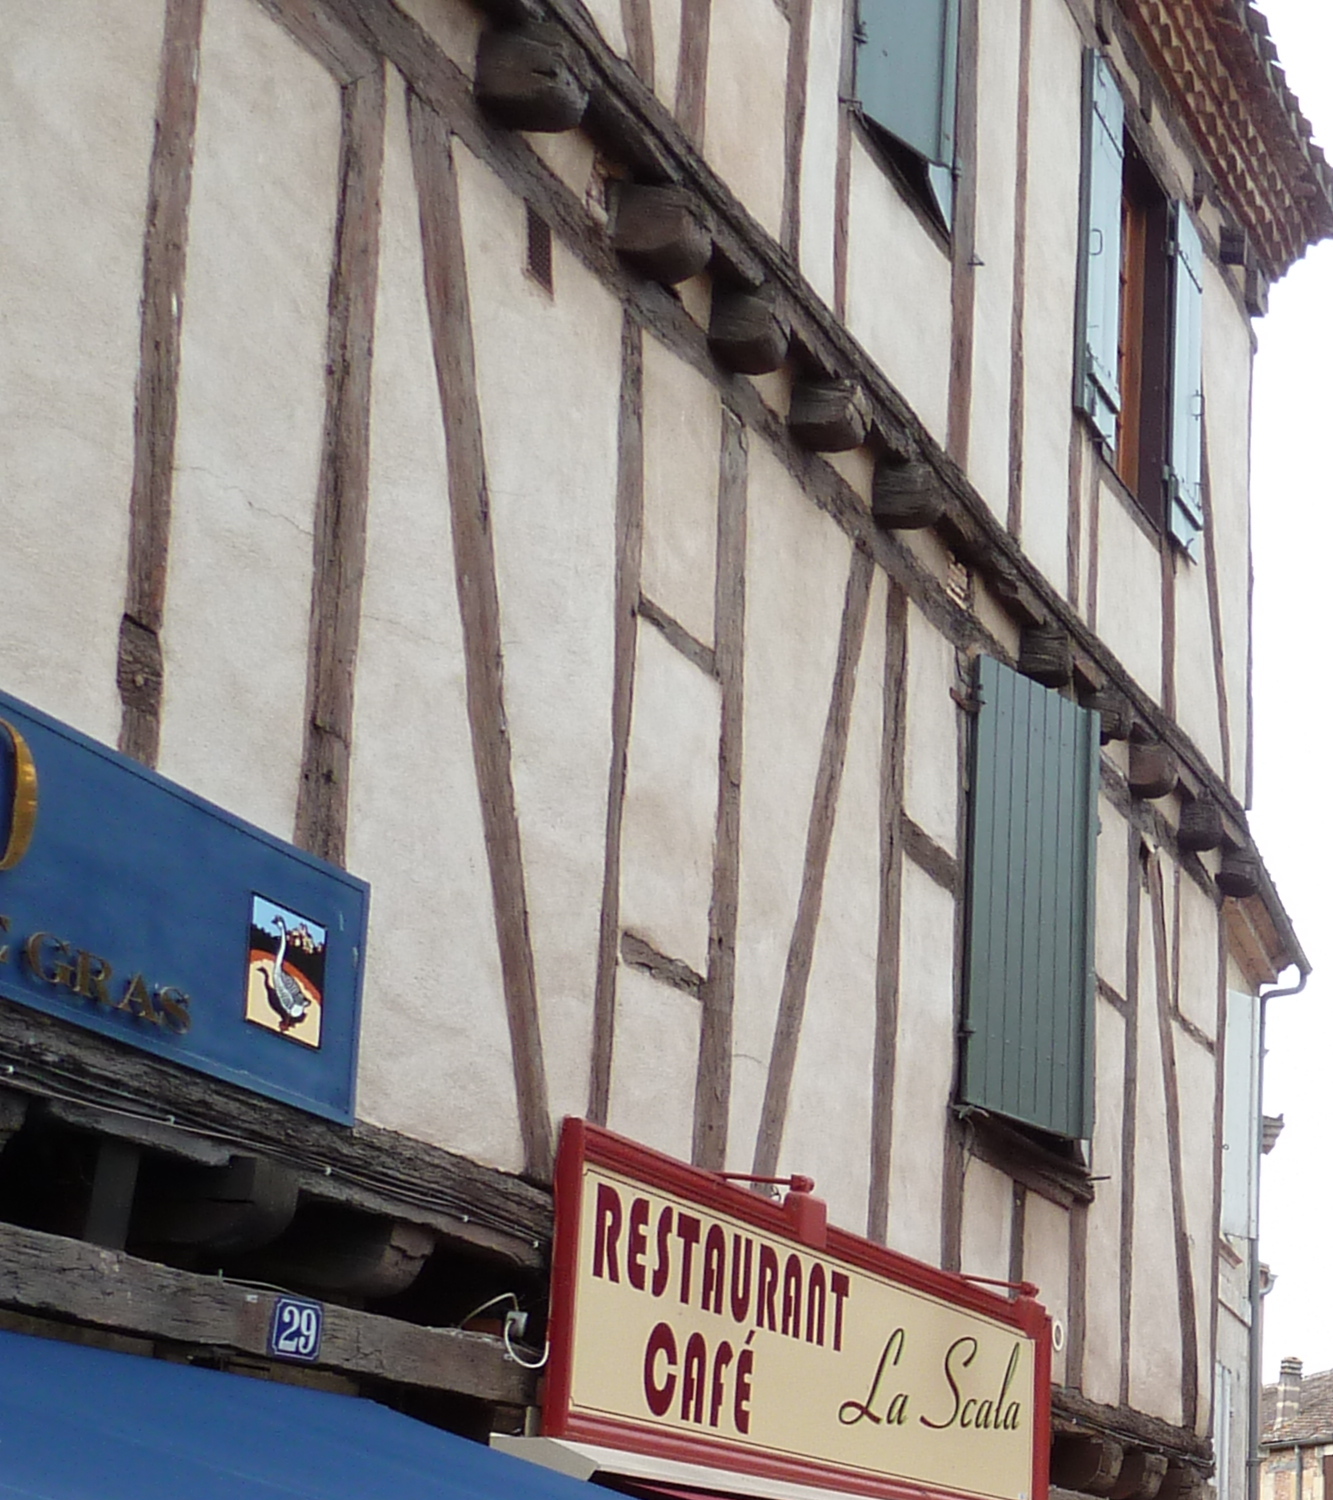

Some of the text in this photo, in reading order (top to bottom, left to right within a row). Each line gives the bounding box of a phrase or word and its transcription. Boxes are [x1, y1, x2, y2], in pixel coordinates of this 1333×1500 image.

[27, 932, 192, 1035] GRAS
[592, 1182, 849, 1352] RESTAURANT
[279, 1306, 316, 1353] 29
[644, 1322, 754, 1435] CAFÉ
[838, 1328, 1020, 1431] La Scala
